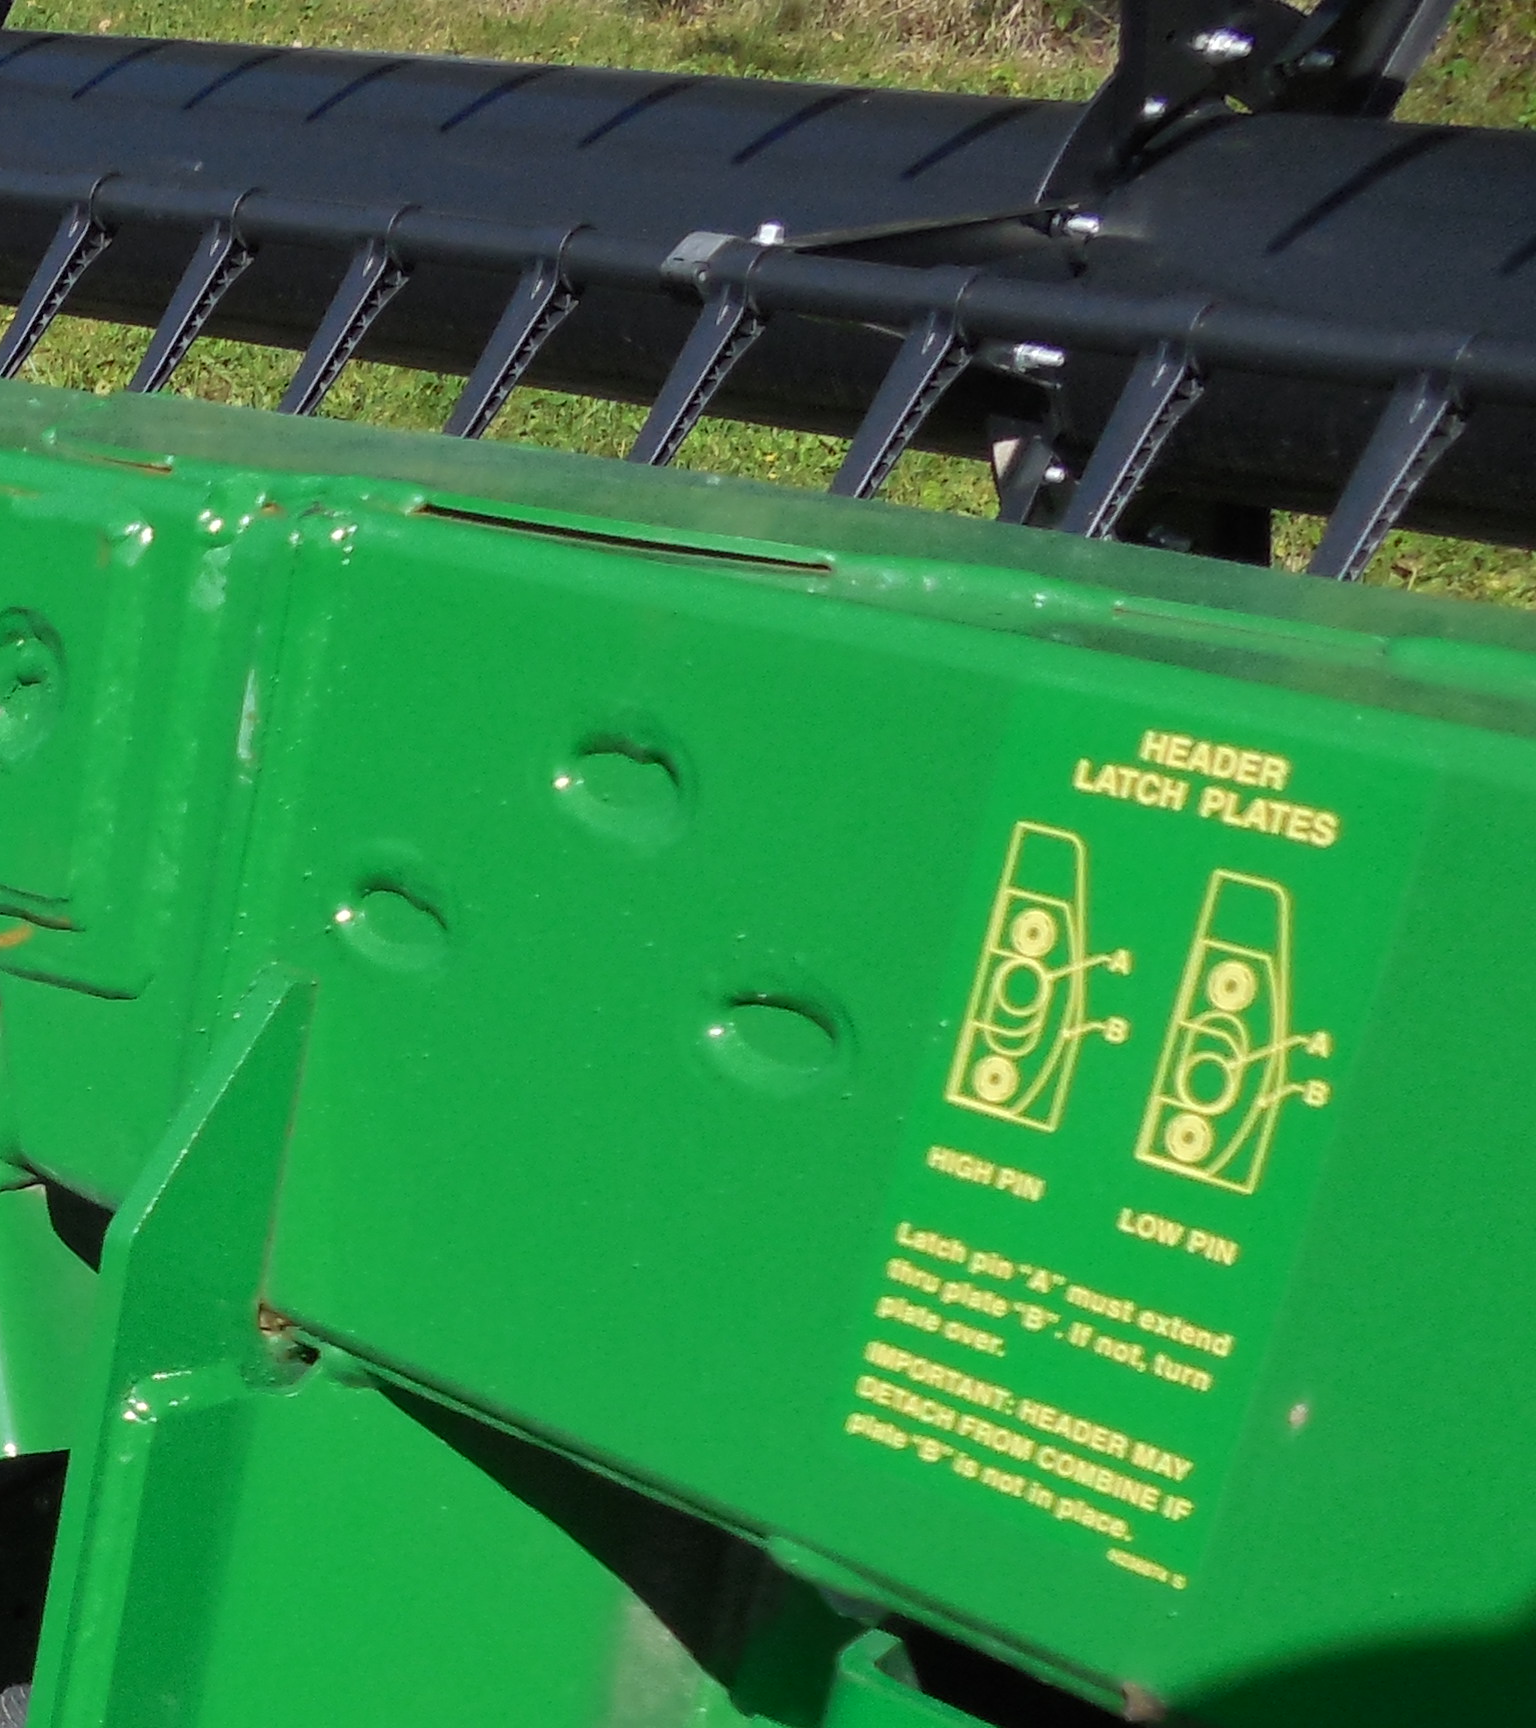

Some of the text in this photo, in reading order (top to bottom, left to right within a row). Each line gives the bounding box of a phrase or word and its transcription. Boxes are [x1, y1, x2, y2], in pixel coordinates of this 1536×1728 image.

[1139, 729, 1291, 791] HEADER
[1073, 758, 1341, 848] LATCH PLATES
[1109, 948, 1132, 975] A
[1105, 1017, 1130, 1044] B
[1307, 1031, 1333, 1057] A
[1303, 1080, 1330, 1108] B
[926, 1145, 1046, 1202] HIGH PIN
[1116, 1207, 1241, 1266] LOW PIN
[895, 1221, 967, 1263] Latch
[967, 1251, 1015, 1282] pin
[1065, 1284, 1135, 1324] must
[1136, 1309, 1235, 1358] extend
[874, 1296, 1006, 1358] plate over.
[886, 1257, 940, 1294] thru
[940, 1280, 1009, 1318] plate
[1067, 1321, 1093, 1348] If
[1152, 1353, 1215, 1391] turn
[865, 1340, 1195, 1483] IMPORTANT: HEADER MAY
[845, 1412, 909, 1450] plate
[953, 1452, 980, 1480] is
[980, 1465, 1027, 1499] not
[1027, 1483, 1055, 1511] in
[1052, 1495, 1135, 1542] place.
[855, 1375, 1196, 1522] DETACH FROM COMBINE IF
